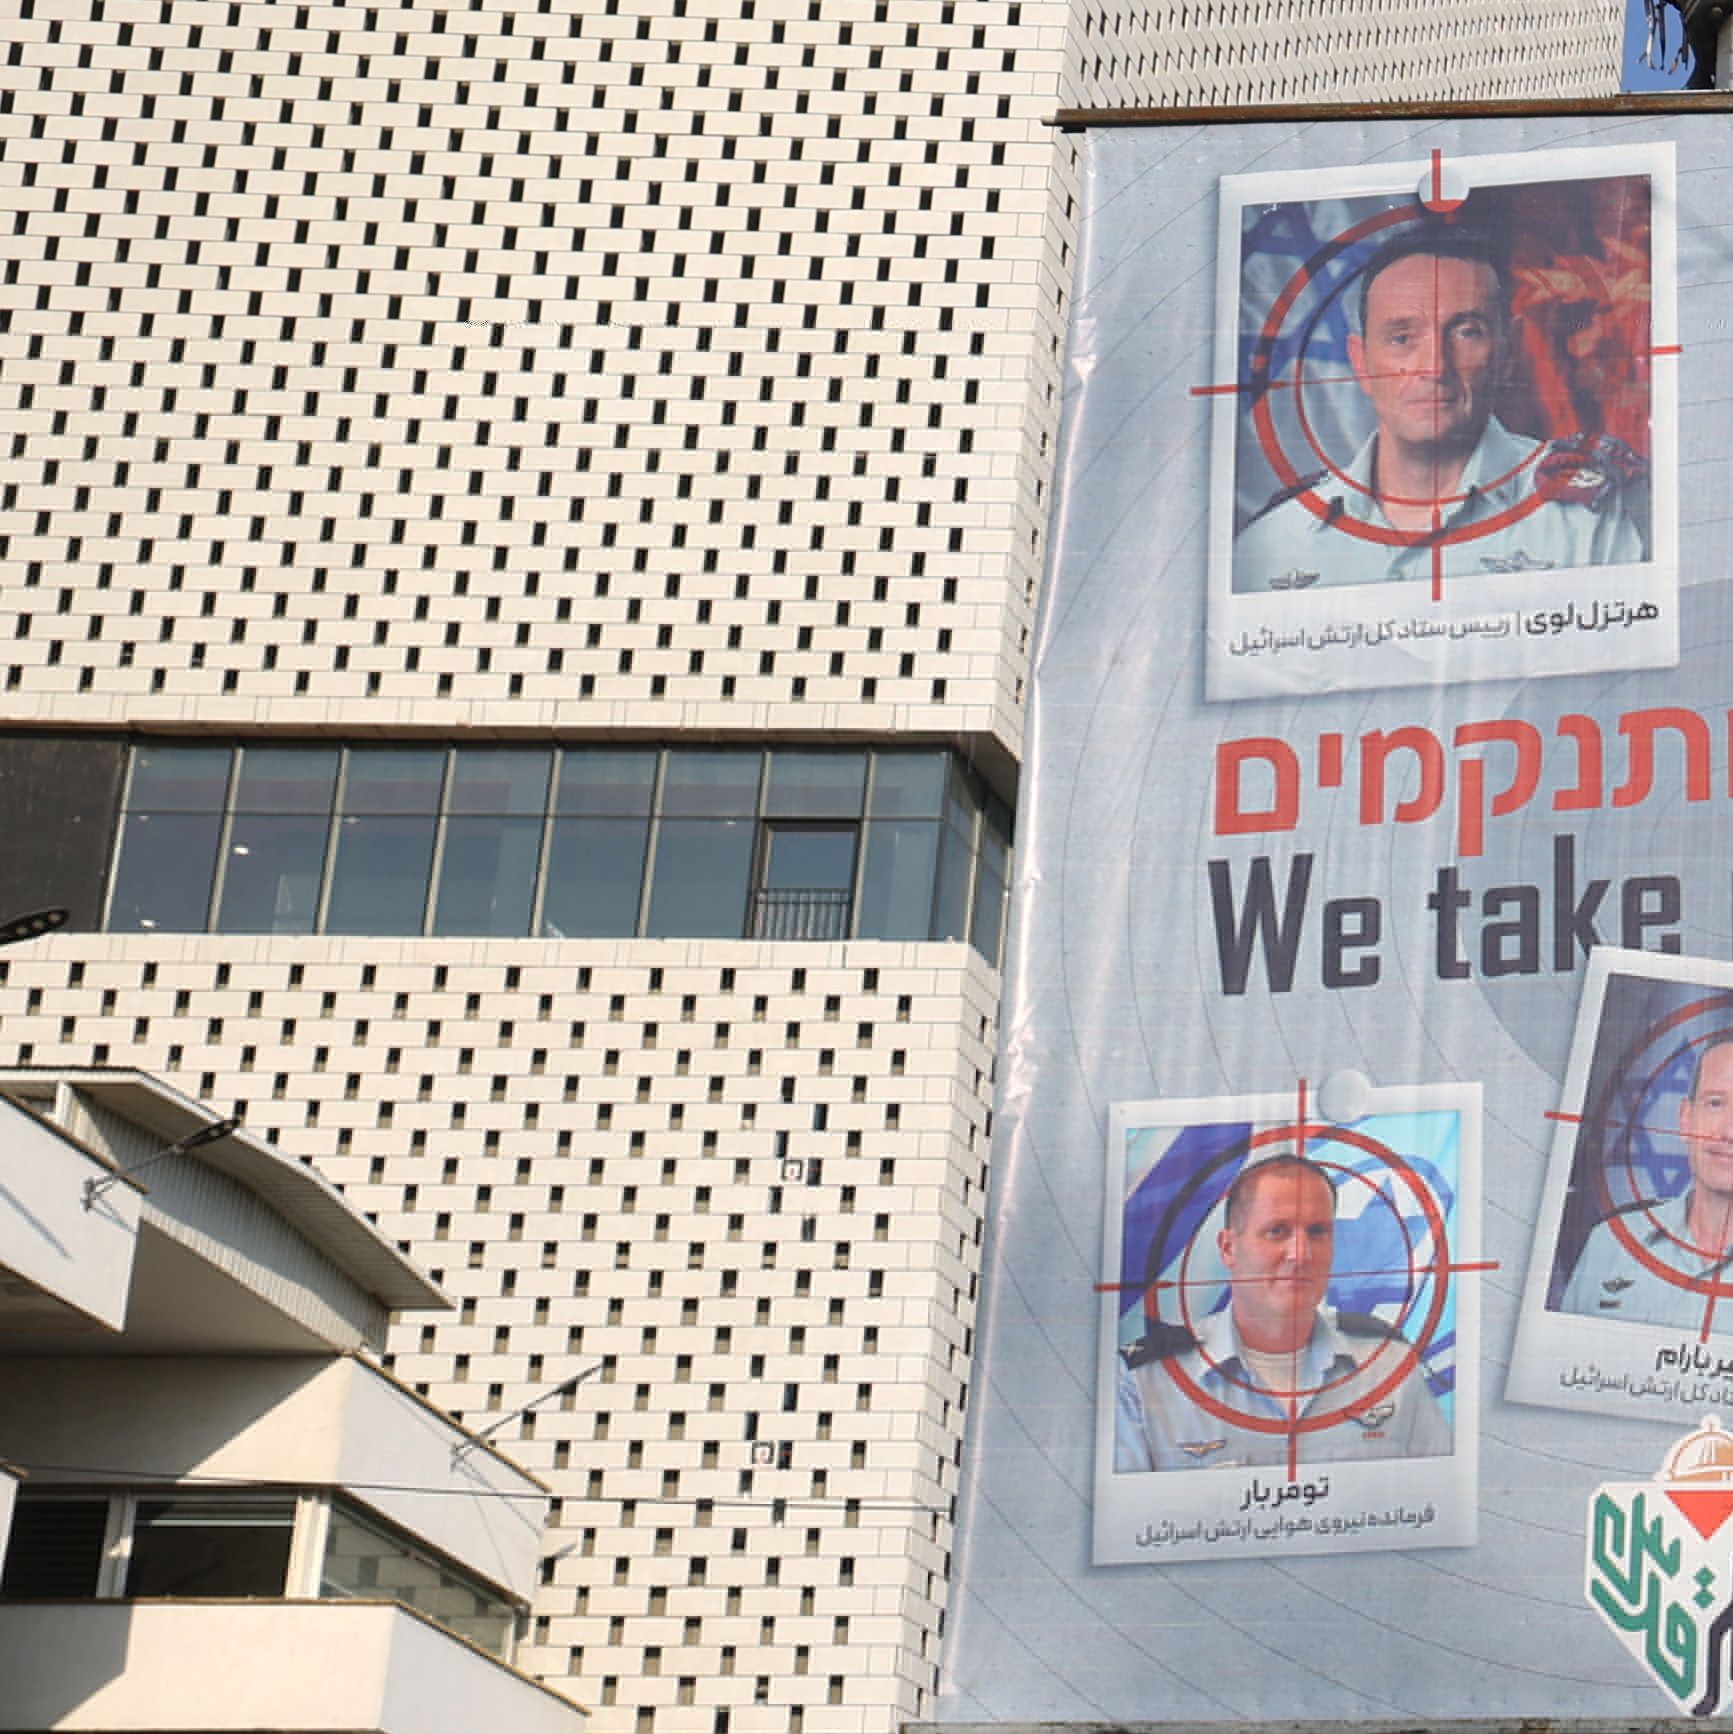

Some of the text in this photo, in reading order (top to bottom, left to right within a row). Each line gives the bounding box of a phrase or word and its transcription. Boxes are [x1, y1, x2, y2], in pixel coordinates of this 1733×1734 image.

[1365, 616, 1397, 647] کل
[1525, 601, 1575, 635] لوی
[1576, 599, 1660, 632] هرتزل
[1228, 625, 1305, 656] اسرائیل
[1305, 623, 1364, 650] ارتش
[1207, 851, 1383, 997] We
[1427, 833, 1683, 980] take
[1655, 1342, 1711, 1376] بارام
[1239, 1476, 1330, 1513] تومر بار
